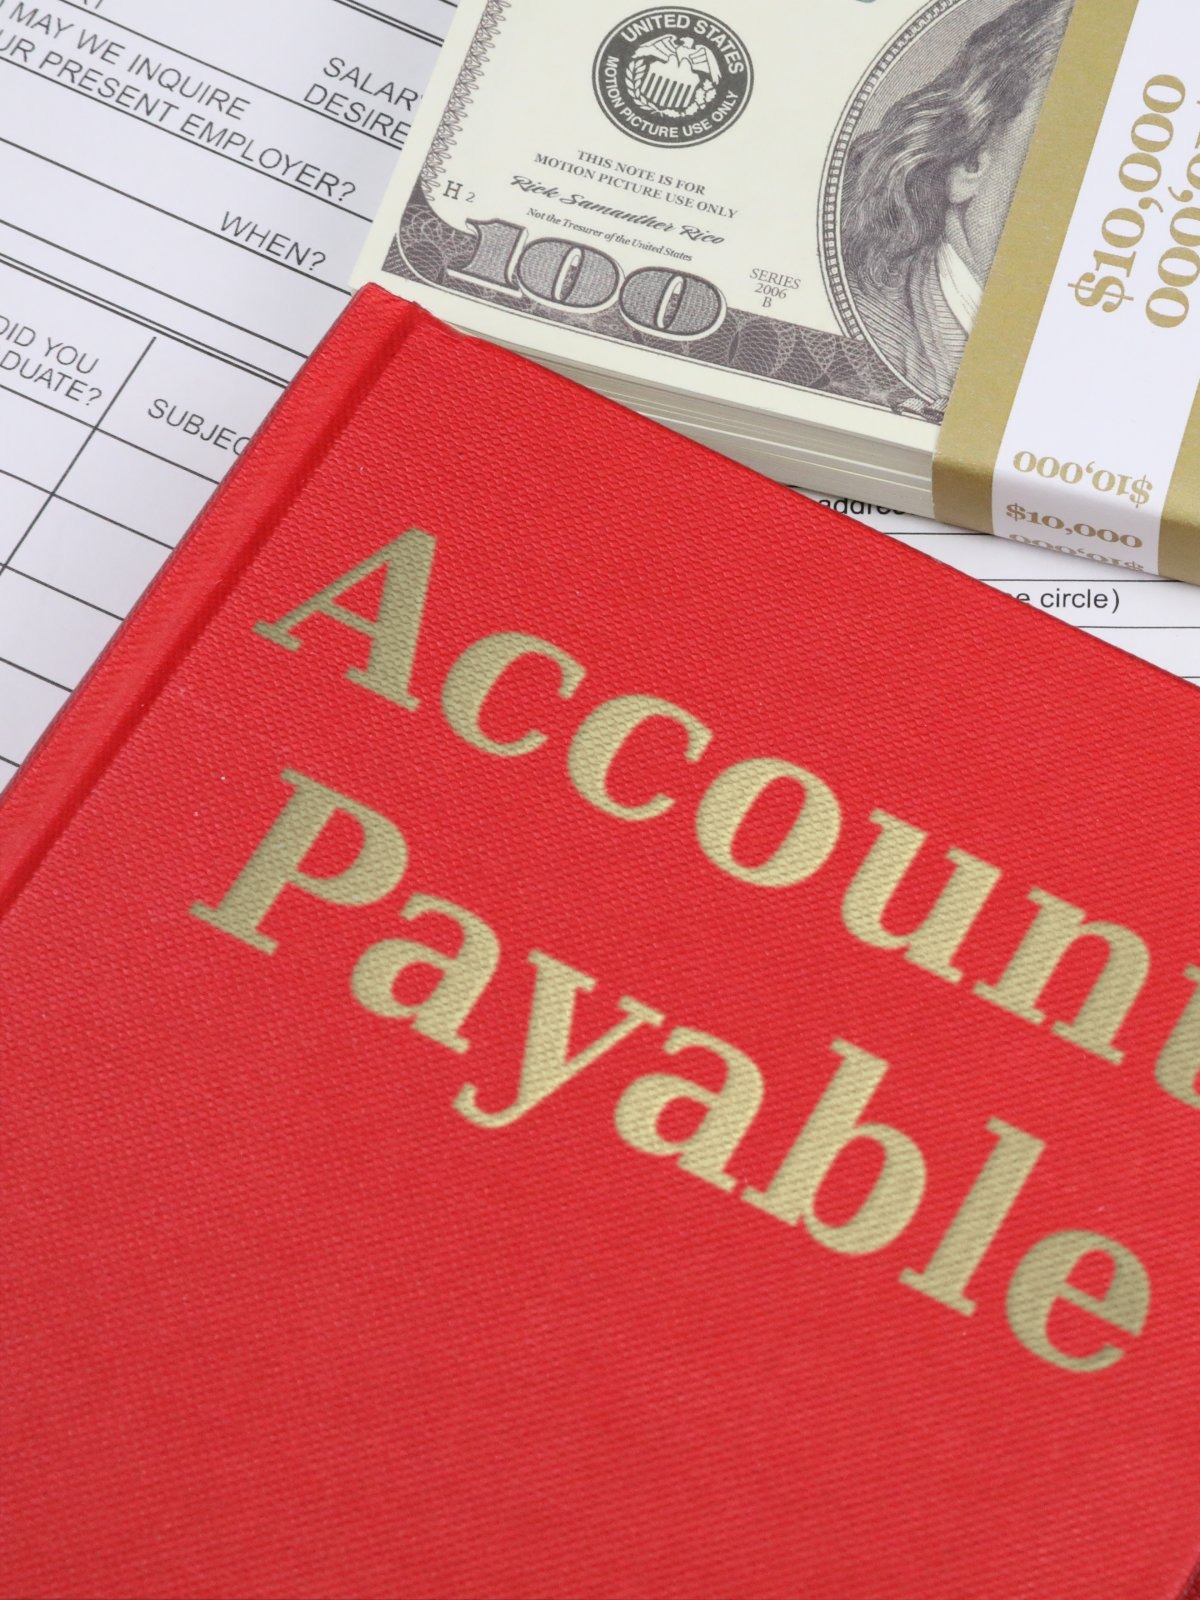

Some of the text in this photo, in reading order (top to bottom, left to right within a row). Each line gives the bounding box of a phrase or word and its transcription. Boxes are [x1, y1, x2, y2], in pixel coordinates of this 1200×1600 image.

[9, 2, 251, 120] MAY WE INQUIRE
[621, 14, 744, 74] UNITED STATES
[323, 57, 423, 111] SALAR
[604, 55, 739, 138] MOTION PICTURE USE ONLY
[38, 50, 179, 123] PRESENT
[179, 113, 356, 202] EMPLOYER?
[303, 83, 412, 144] DESIRE
[534, 153, 738, 219] MOTION PICTURE USE ONLY
[577, 150, 706, 196] THIS NOTE IS FOR
[1068, 74, 1186, 313] $10,000
[510, 174, 559, 199] Rick
[679, 224, 725, 245] Rico
[526, 207, 693, 262] Not the Tresurer of the United States
[220, 211, 326, 271] WHEN?
[447, 217, 728, 341] 100
[749, 267, 801, 290] SERIES
[754, 282, 787, 299] 2006
[762, 296, 772, 308] B
[0, 350, 102, 406] DUATE?
[44, 337, 99, 374] YOU
[1013, 451, 1153, 508] $10,000
[1006, 502, 1143, 548] $10,000
[1040, 587, 1120, 614] circle)
[188, 768, 1152, 1374] Payable
